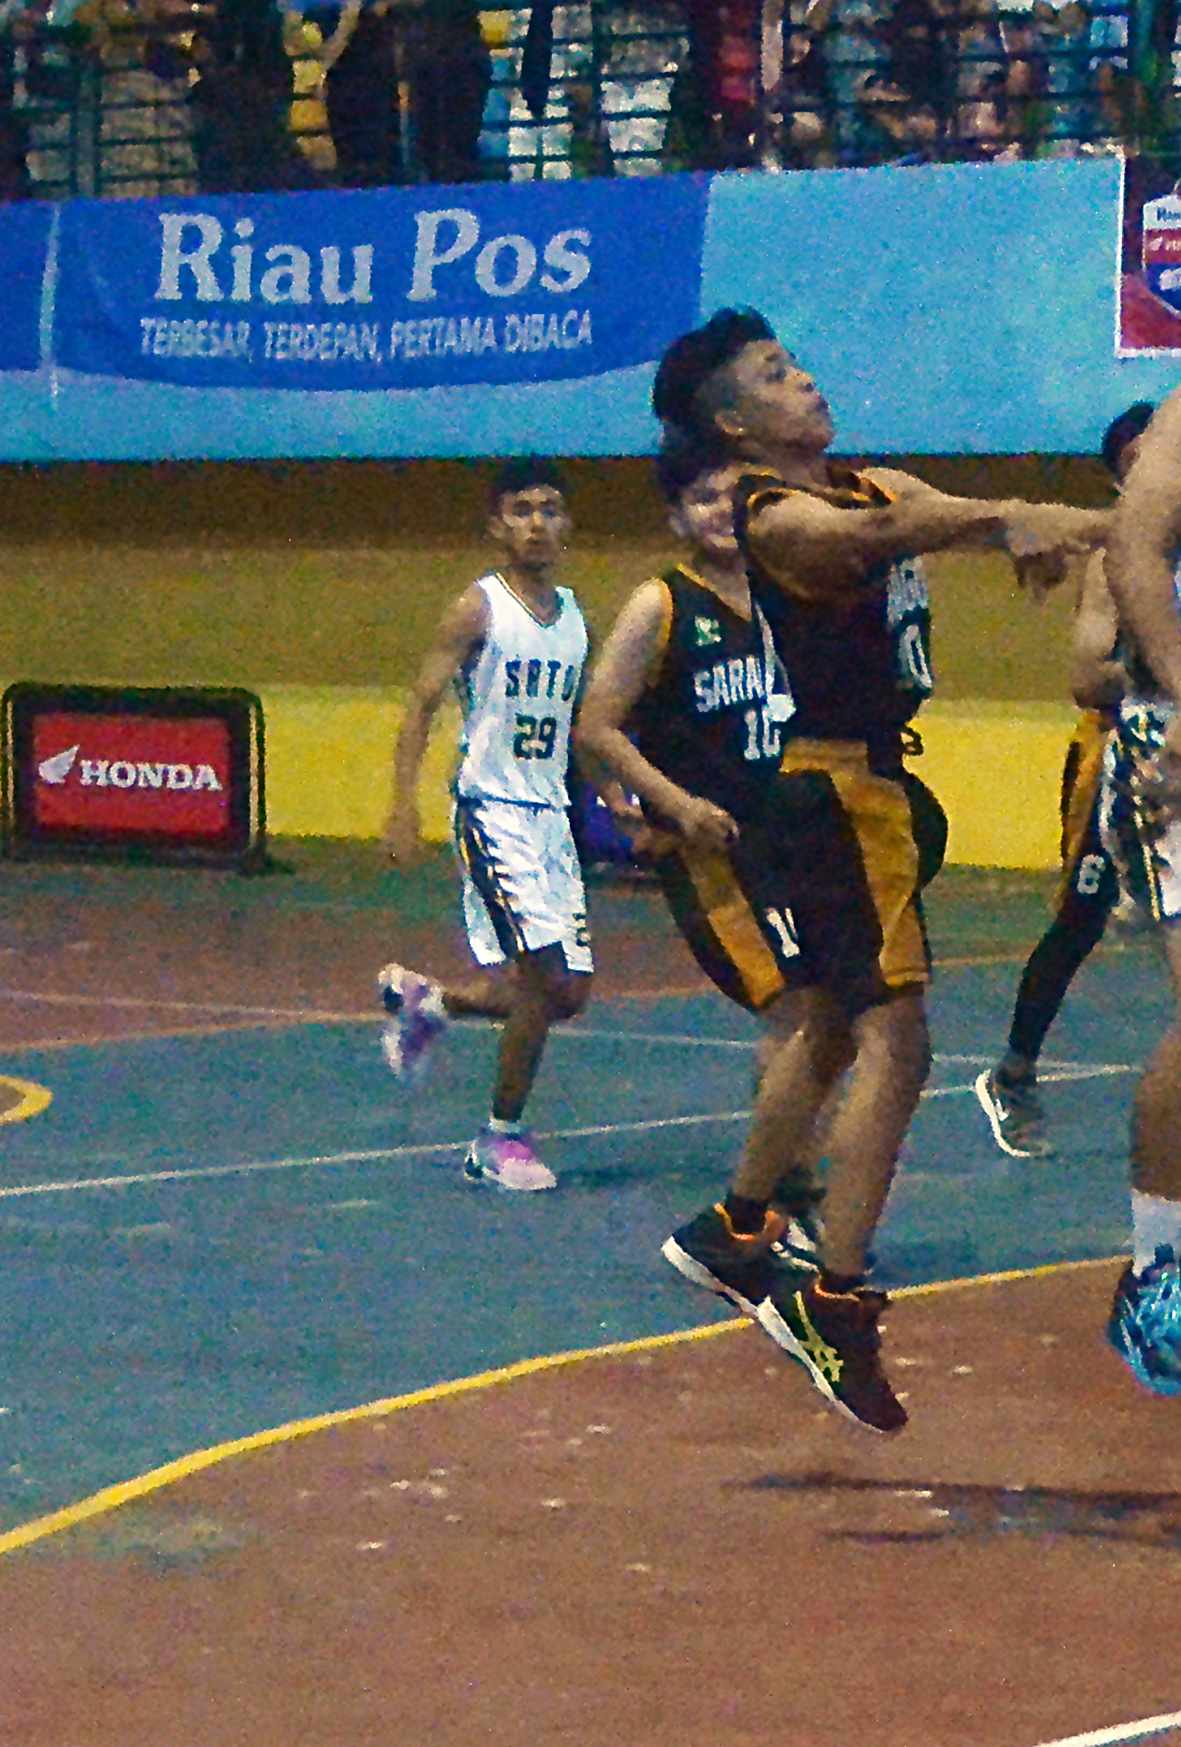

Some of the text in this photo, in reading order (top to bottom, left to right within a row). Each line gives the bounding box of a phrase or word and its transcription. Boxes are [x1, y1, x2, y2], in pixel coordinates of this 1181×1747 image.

[154, 208, 592, 304] Riau Pos
[505, 659, 577, 701] SATU
[513, 714, 557, 760] 29
[79, 760, 223, 791] HONDA
